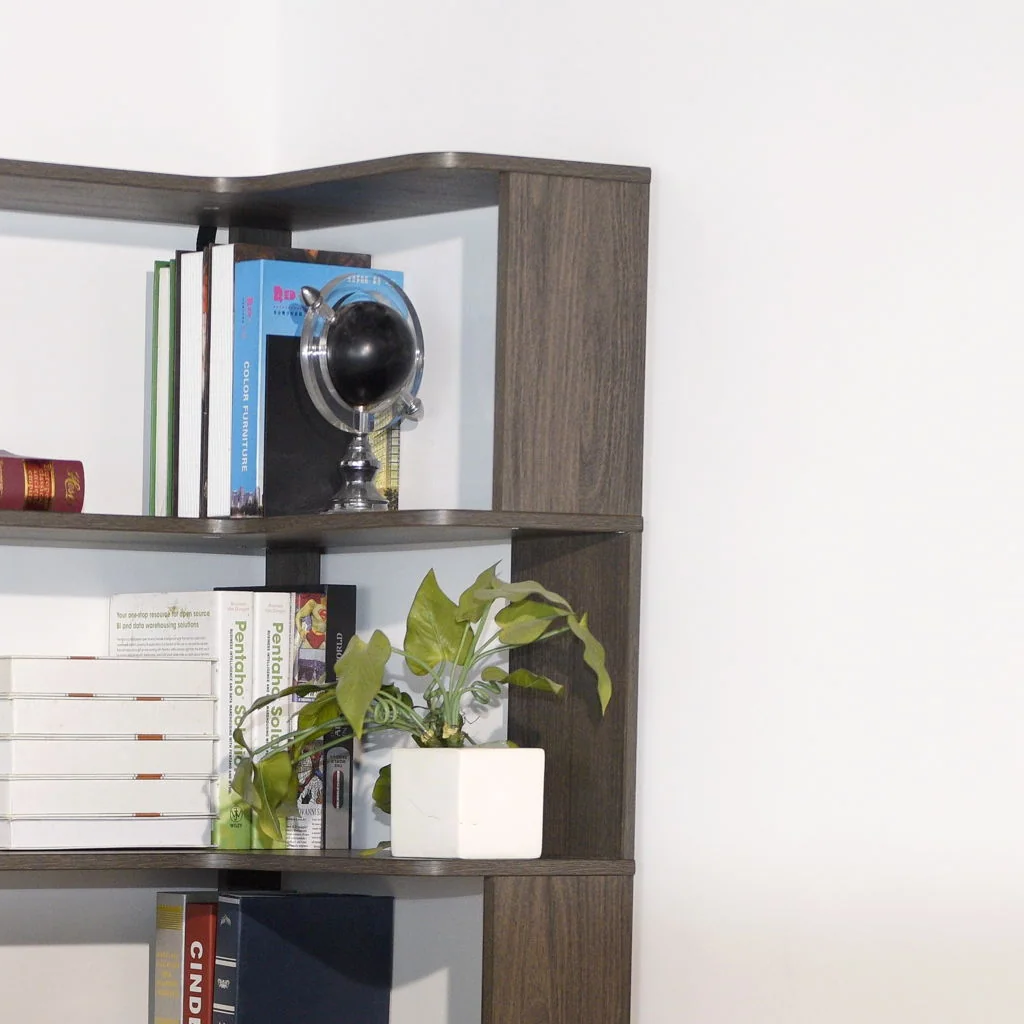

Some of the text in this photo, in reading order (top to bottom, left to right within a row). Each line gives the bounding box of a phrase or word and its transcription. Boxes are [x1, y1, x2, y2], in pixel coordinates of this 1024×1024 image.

[241, 360, 250, 473] COLOR FURNITURE
[234, 620, 247, 697] Pentaho
